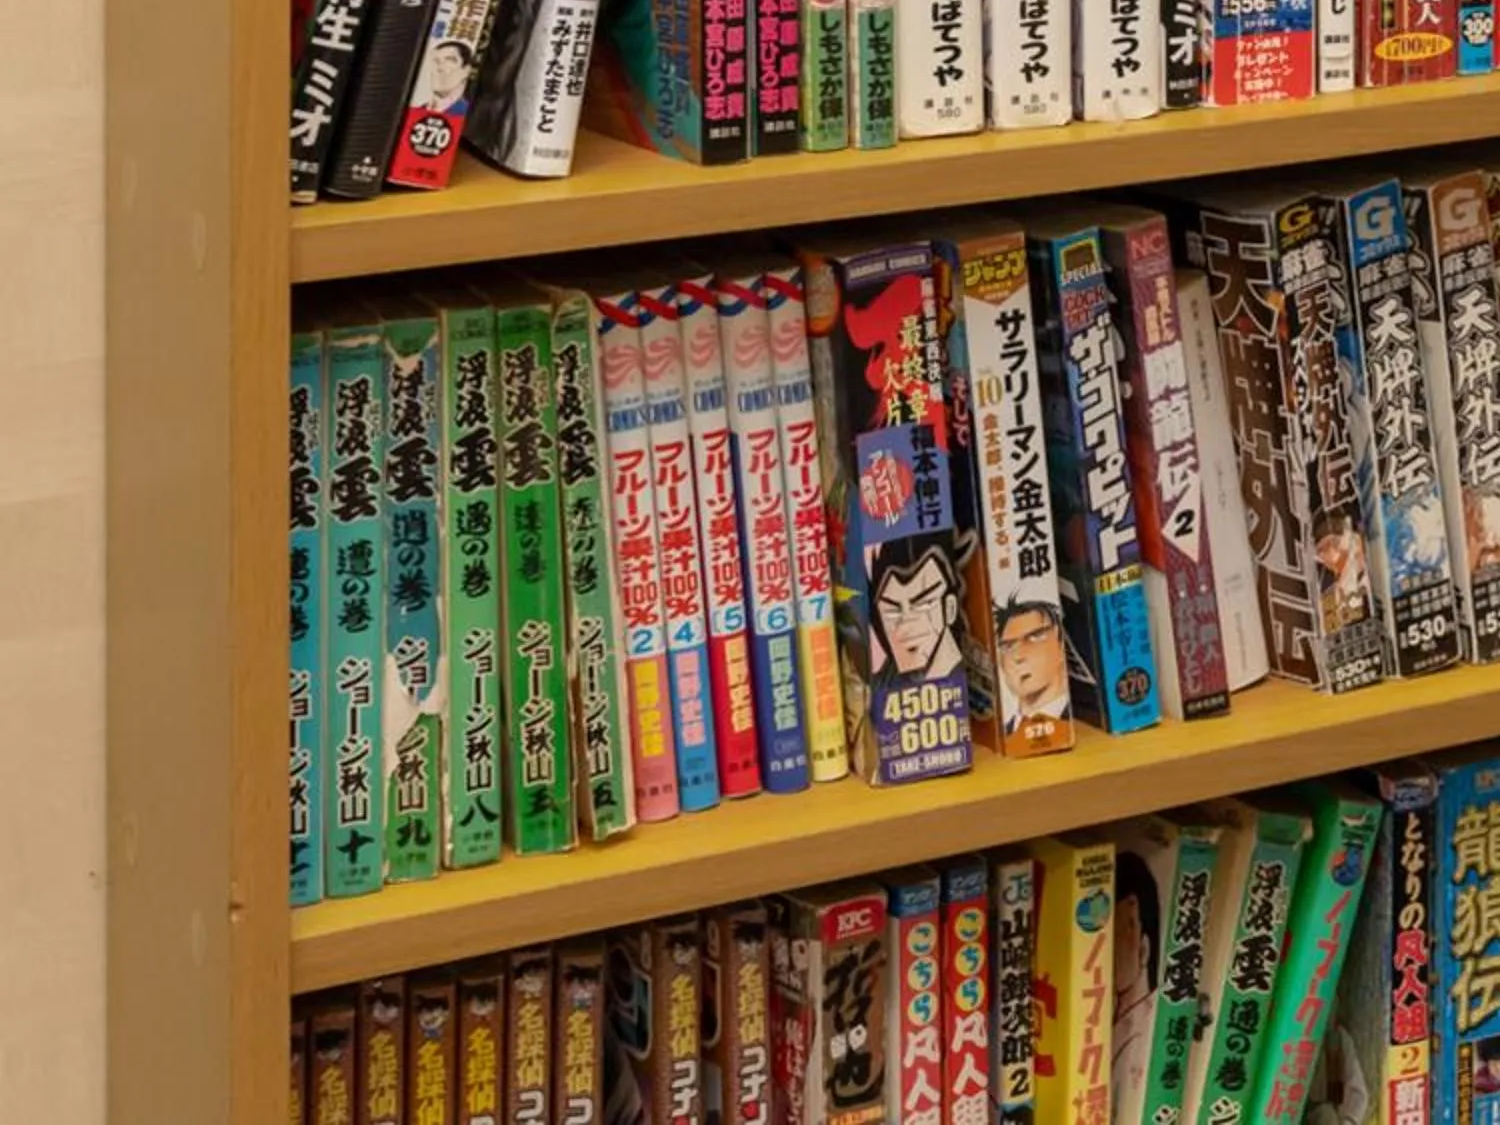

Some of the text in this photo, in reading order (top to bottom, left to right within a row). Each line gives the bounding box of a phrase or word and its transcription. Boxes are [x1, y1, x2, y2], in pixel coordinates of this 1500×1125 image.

[536, 19, 576, 135] みずたまこと
[565, 19, 594, 98] 井口達也
[818, 9, 843, 120] しもさか保
[867, 9, 893, 120] しもさか保
[409, 123, 450, 145] 370
[329, 374, 381, 524] 浮浪雲
[449, 347, 499, 493] 浮浪雲
[993, 306, 1052, 580] サラリーマン金太郎
[1369, 297, 1433, 501] 天牌外伝
[612, 449, 659, 654] フルーツ果汁100% 2
[654, 440, 699, 644] フルーツ果汁100% 4
[701, 426, 745, 606] フルーツ果汁100%
[746, 427, 791, 605] フルーツ果汁100%
[516, 620, 555, 786] ジョージ秋山
[1408, 616, 1447, 645] 530
[335, 656, 376, 827] ジョージ秋山
[461, 628, 500, 793] ジョージ秋山
[336, 828, 375, 866] 十
[459, 794, 500, 826] 八
[1231, 861, 1285, 995] 浮浪雲
